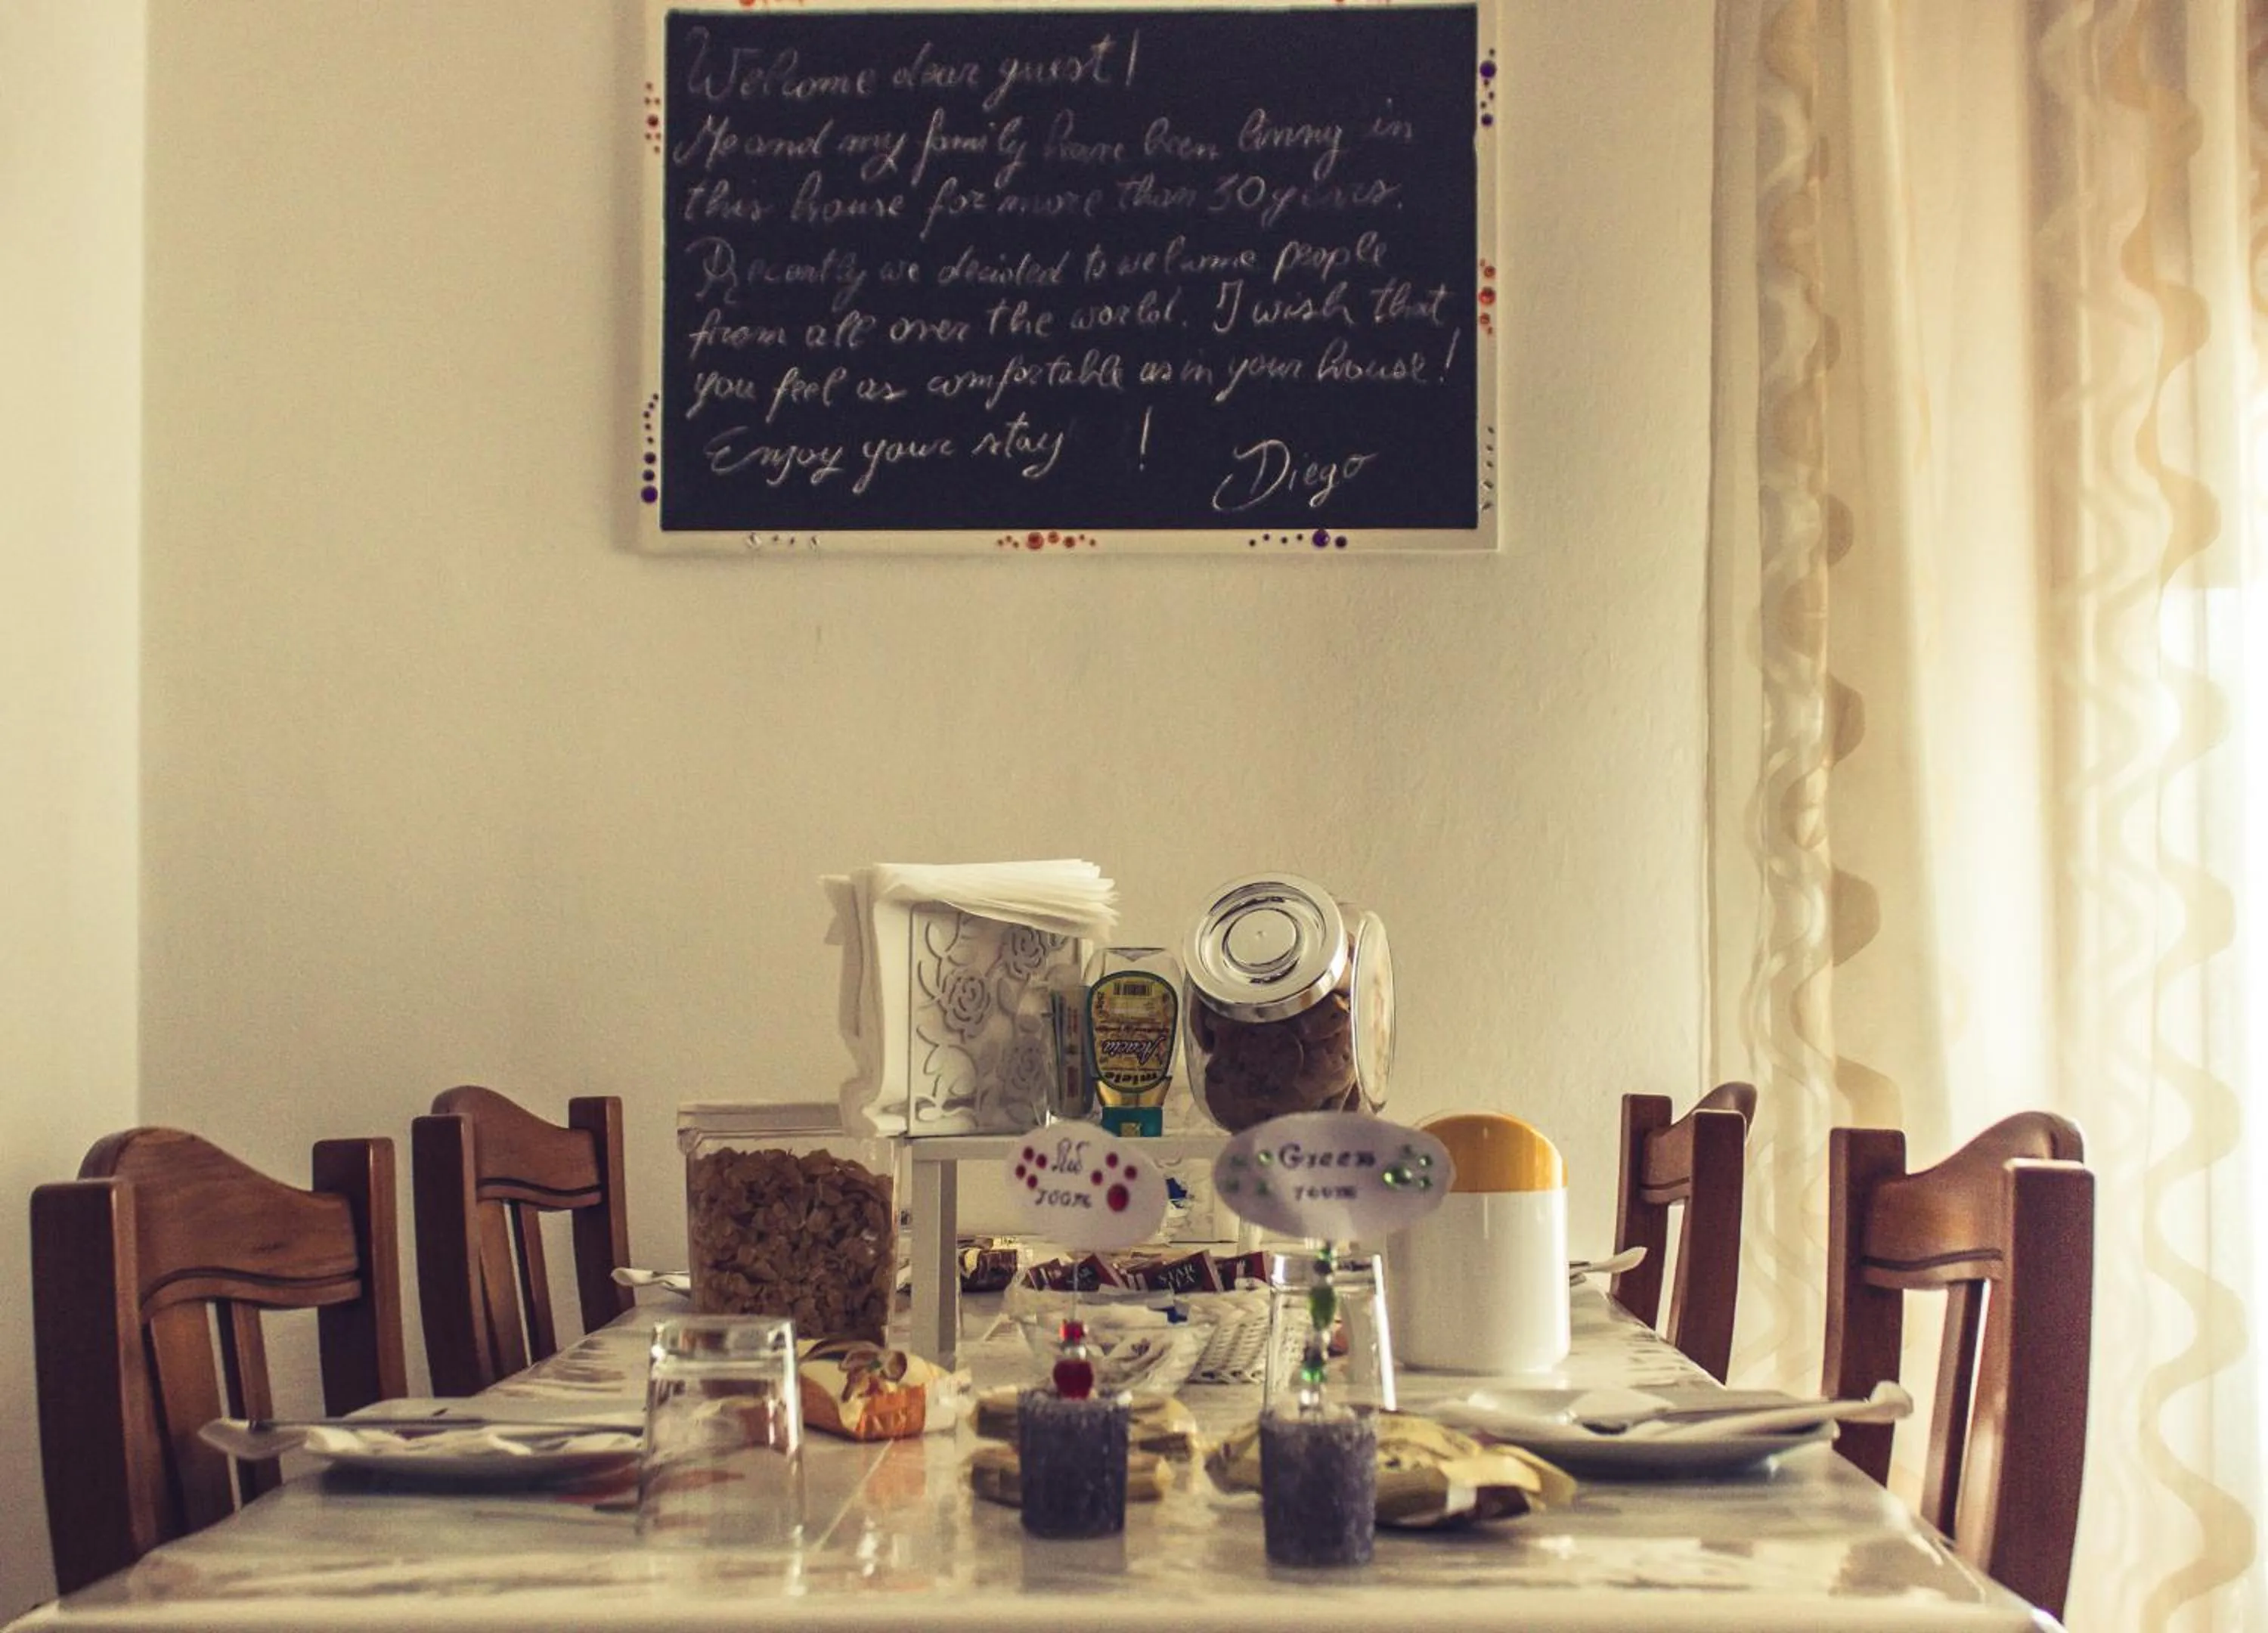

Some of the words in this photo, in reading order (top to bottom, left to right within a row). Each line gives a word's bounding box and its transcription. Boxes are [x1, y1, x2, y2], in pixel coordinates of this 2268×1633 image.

[686, 26, 876, 101] Welcome
[893, 41, 980, 88] dear
[672, 114, 739, 171] Me
[744, 118, 834, 156] and
[837, 131, 906, 181] my
[911, 107, 1027, 189] family
[1043, 108, 1126, 162] have
[1371, 97, 1413, 139] in
[684, 178, 774, 221] this
[790, 170, 905, 222] house
[919, 176, 985, 241] for
[996, 189, 1102, 217] more
[686, 236, 867, 312] Recently
[880, 261, 921, 284] we
[937, 245, 1070, 287] decided
[1085, 243, 1106, 282] to
[1117, 235, 1256, 276] welcome
[1272, 231, 1387, 284] people
[689, 308, 787, 361] from
[805, 309, 877, 349] all
[888, 316, 971, 344] over
[986, 298, 1055, 337] the
[1213, 278, 1244, 334] I
[1252, 280, 1355, 325] wish
[1370, 277, 1456, 325] that
[686, 370, 757, 420] you
[765, 367, 848, 424] feel
[856, 377, 907, 401] as
[1214, 357, 1303, 403] your
[705, 426, 845, 487] Enjoy
[851, 439, 953, 495] your
[971, 411, 1064, 479] stay
[1212, 438, 1379, 512] Diego
[1278, 1142, 1376, 1170] Green
[1035, 1188, 1092, 1209] room
[1296, 1185, 1359, 1201] room
